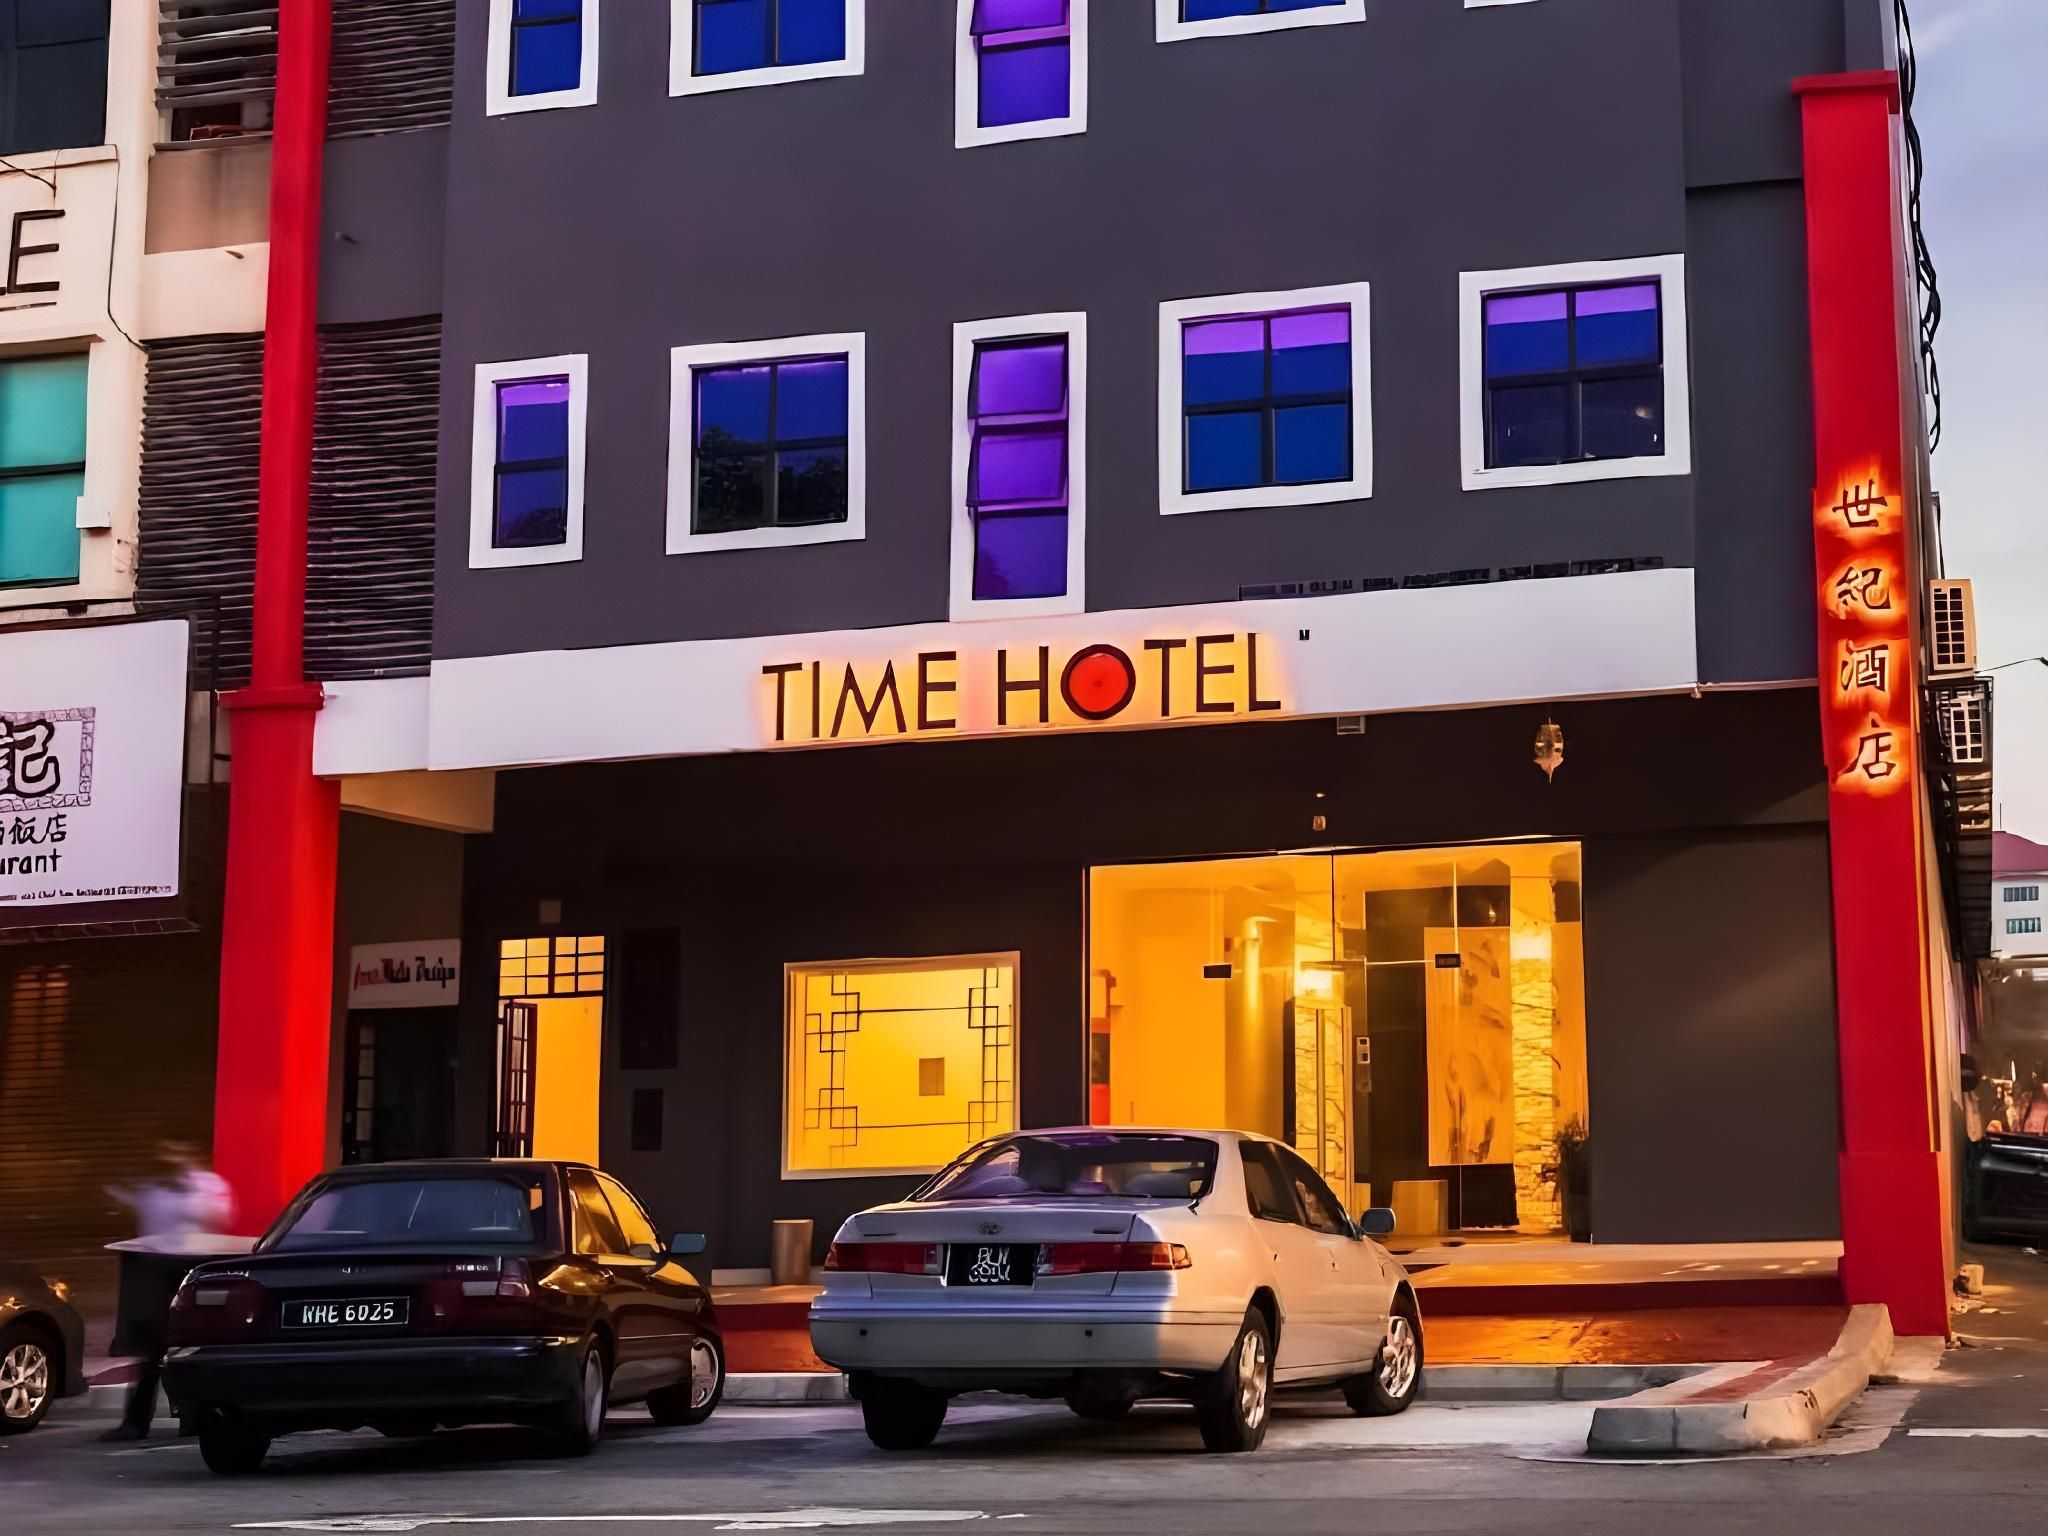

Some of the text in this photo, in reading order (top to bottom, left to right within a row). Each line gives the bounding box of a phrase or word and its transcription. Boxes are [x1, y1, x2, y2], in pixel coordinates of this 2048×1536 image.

[0, 209, 65, 295] E
[1832, 478, 1897, 784] 世紀酒店
[762, 632, 1282, 741] TIME HOTEL
[0, 812, 67, 845] 飯店
[345, 1302, 394, 1321] 6025
